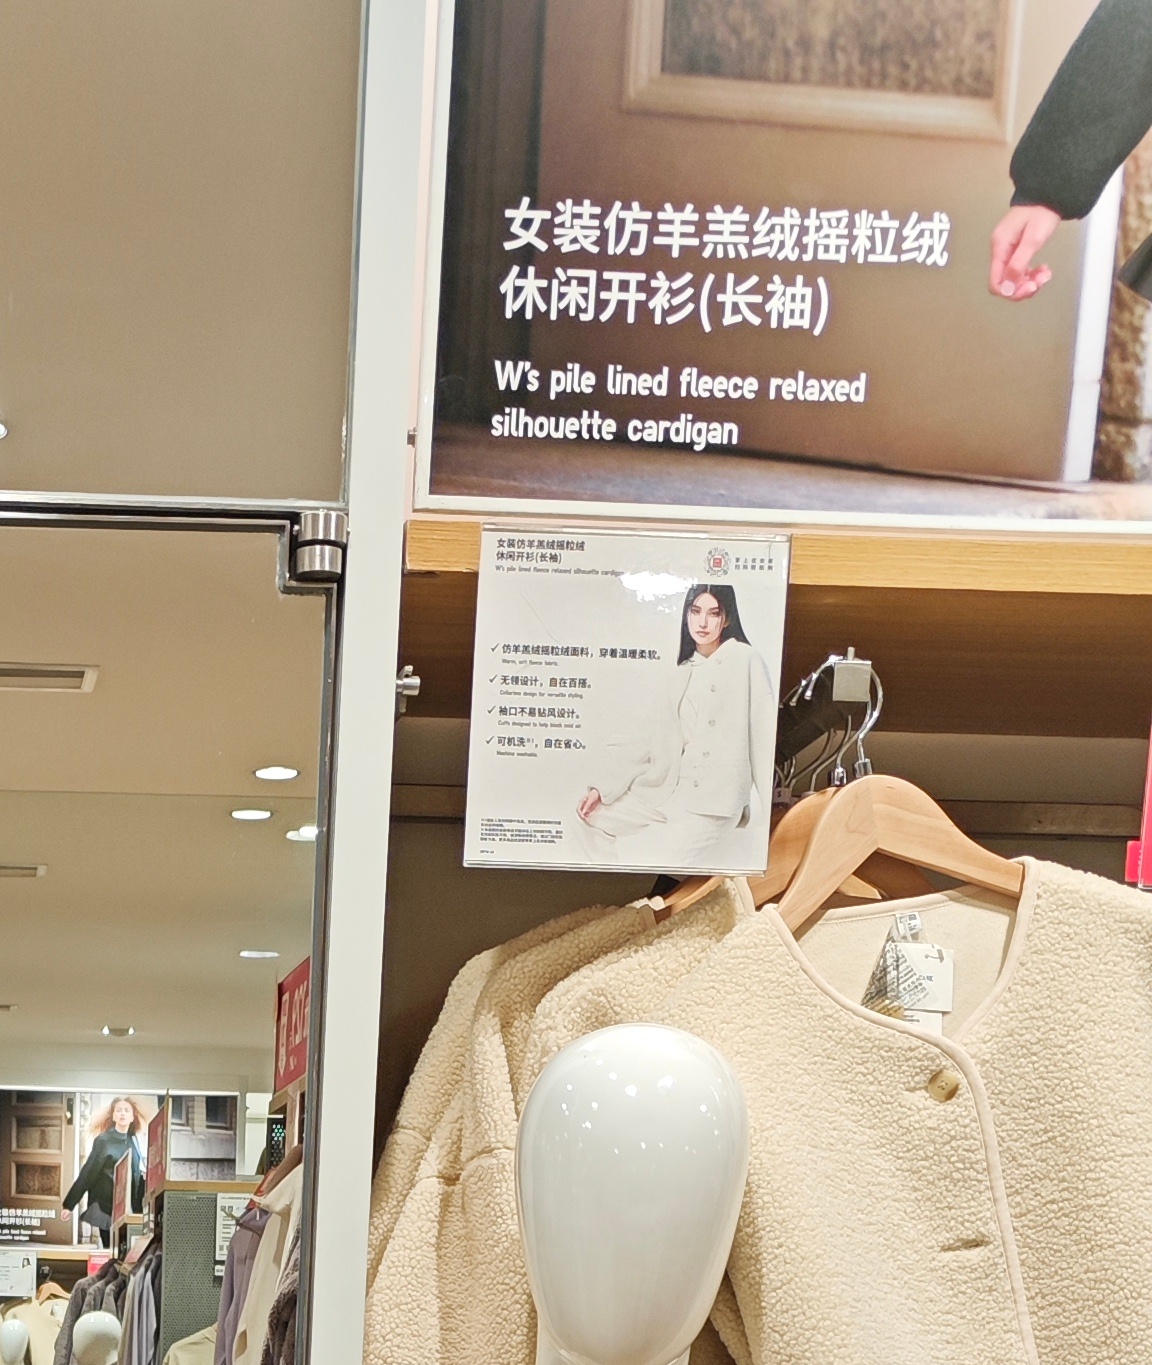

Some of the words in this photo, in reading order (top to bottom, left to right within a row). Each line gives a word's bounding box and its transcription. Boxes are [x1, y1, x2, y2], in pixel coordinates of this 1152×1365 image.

[503, 196, 950, 267] 女装仿羊羔绒摇粒绒
[500, 266, 830, 335] 休闲开衫(长袖)
[494, 360, 540, 393] W's
[549, 363, 596, 400] pile
[607, 365, 668, 397] lined
[679, 366, 759, 401] fleece
[769, 370, 867, 404] relaxed
[491, 408, 617, 442] silhouette
[626, 414, 739, 451] cardigan
